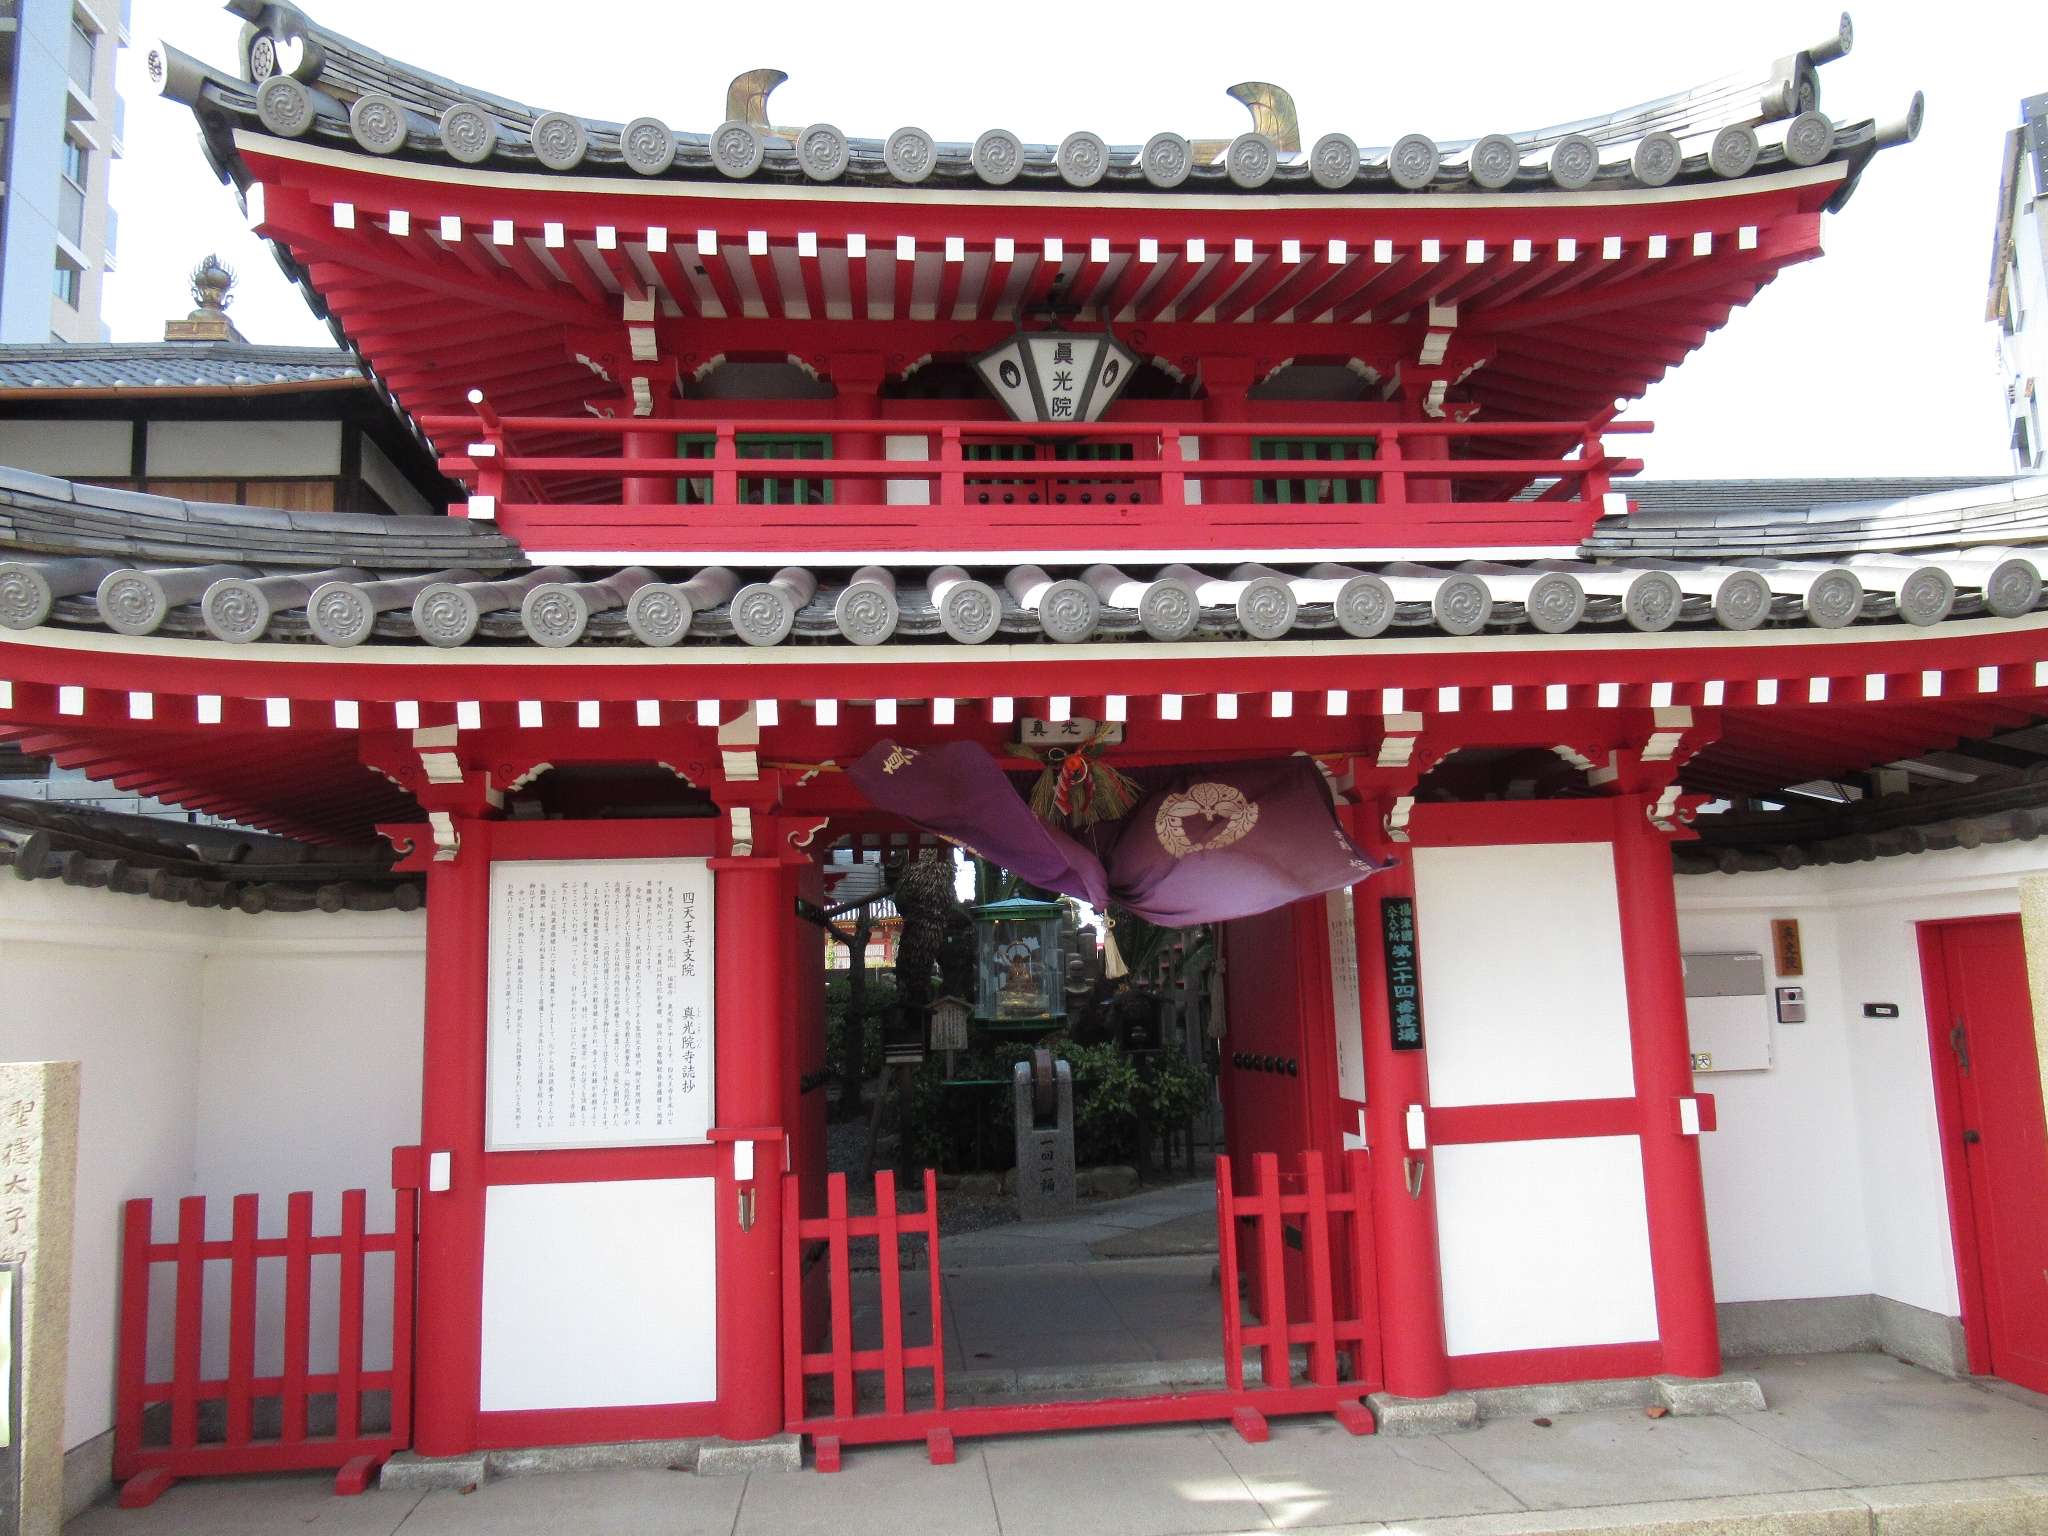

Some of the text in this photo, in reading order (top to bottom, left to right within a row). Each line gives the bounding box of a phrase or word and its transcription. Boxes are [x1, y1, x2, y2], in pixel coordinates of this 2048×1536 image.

[682, 892, 696, 1093] 四天王寺支院 真光院寺誌抄
